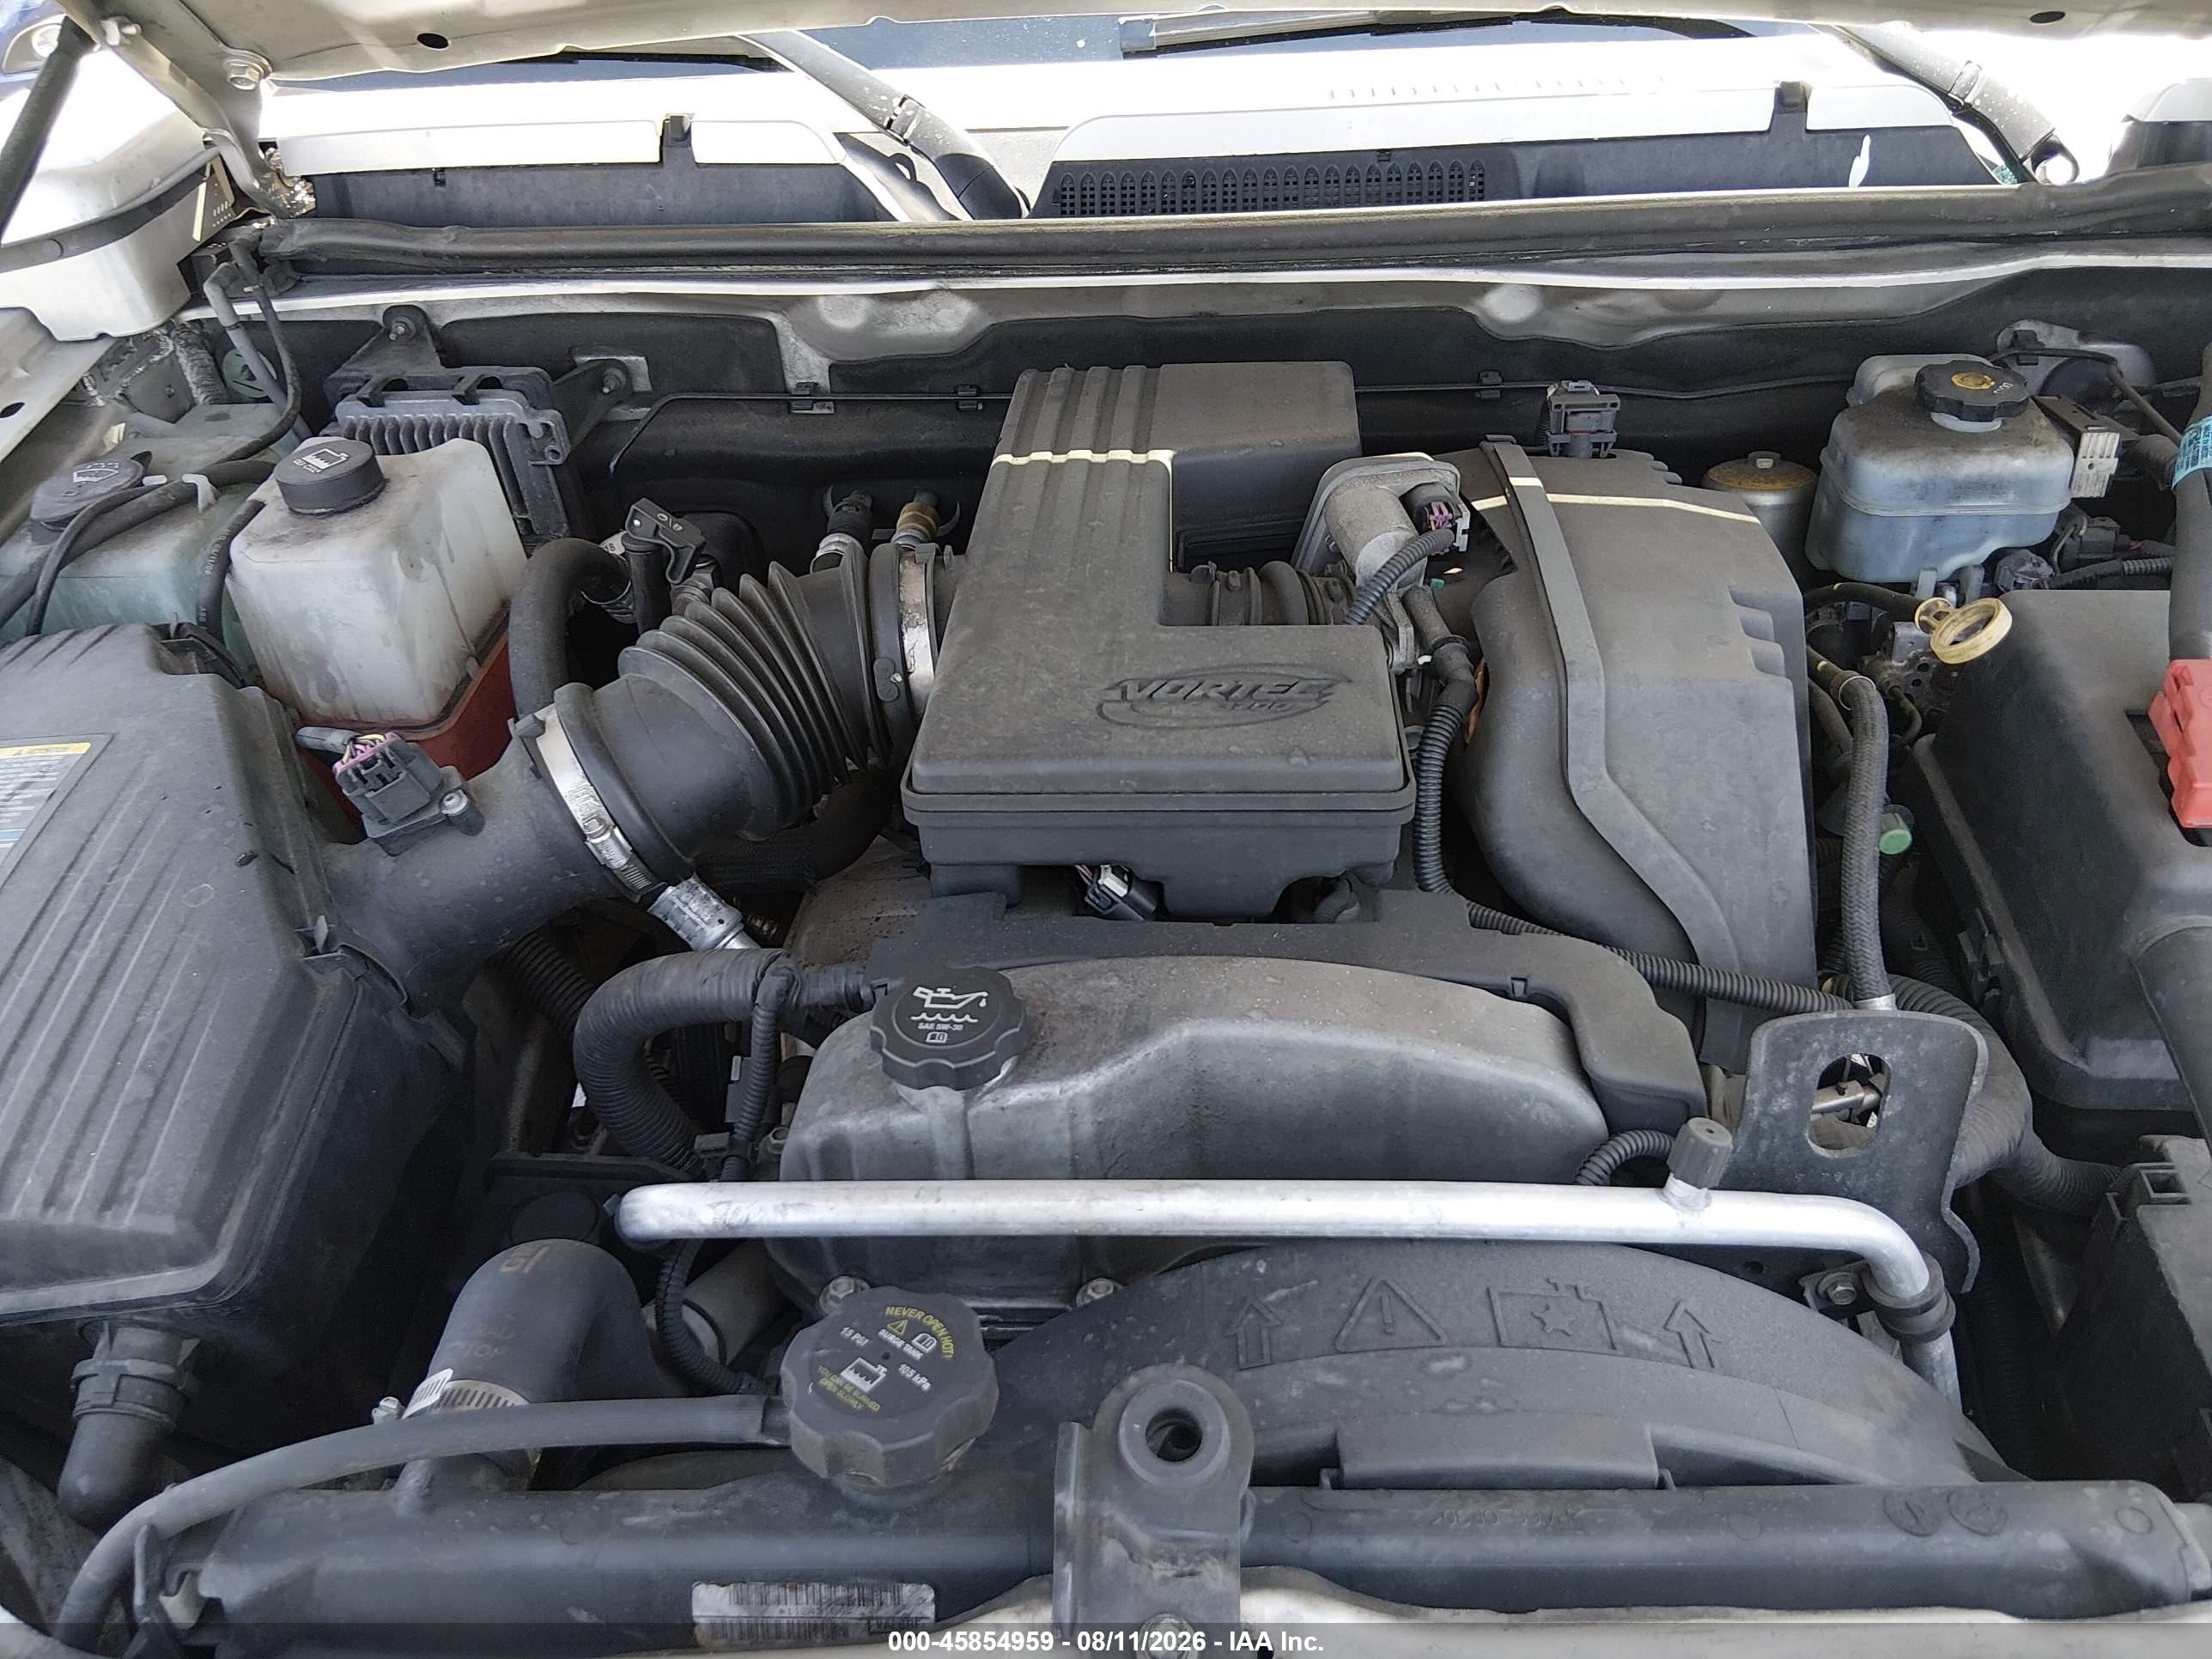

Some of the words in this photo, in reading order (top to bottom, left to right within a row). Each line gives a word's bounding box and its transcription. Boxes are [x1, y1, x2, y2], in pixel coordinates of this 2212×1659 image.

[1118, 678, 1336, 702] VORTEC
[885, 1306, 925, 1320] NEVER
[922, 1315, 949, 1337] OPEN
[841, 1327, 853, 1338] 15
[850, 1330, 870, 1346] PSI
[878, 1328, 906, 1348] SURGE
[902, 1342, 924, 1360] TANK
[898, 1364, 914, 1379] 105
[913, 1373, 933, 1391] kPa
